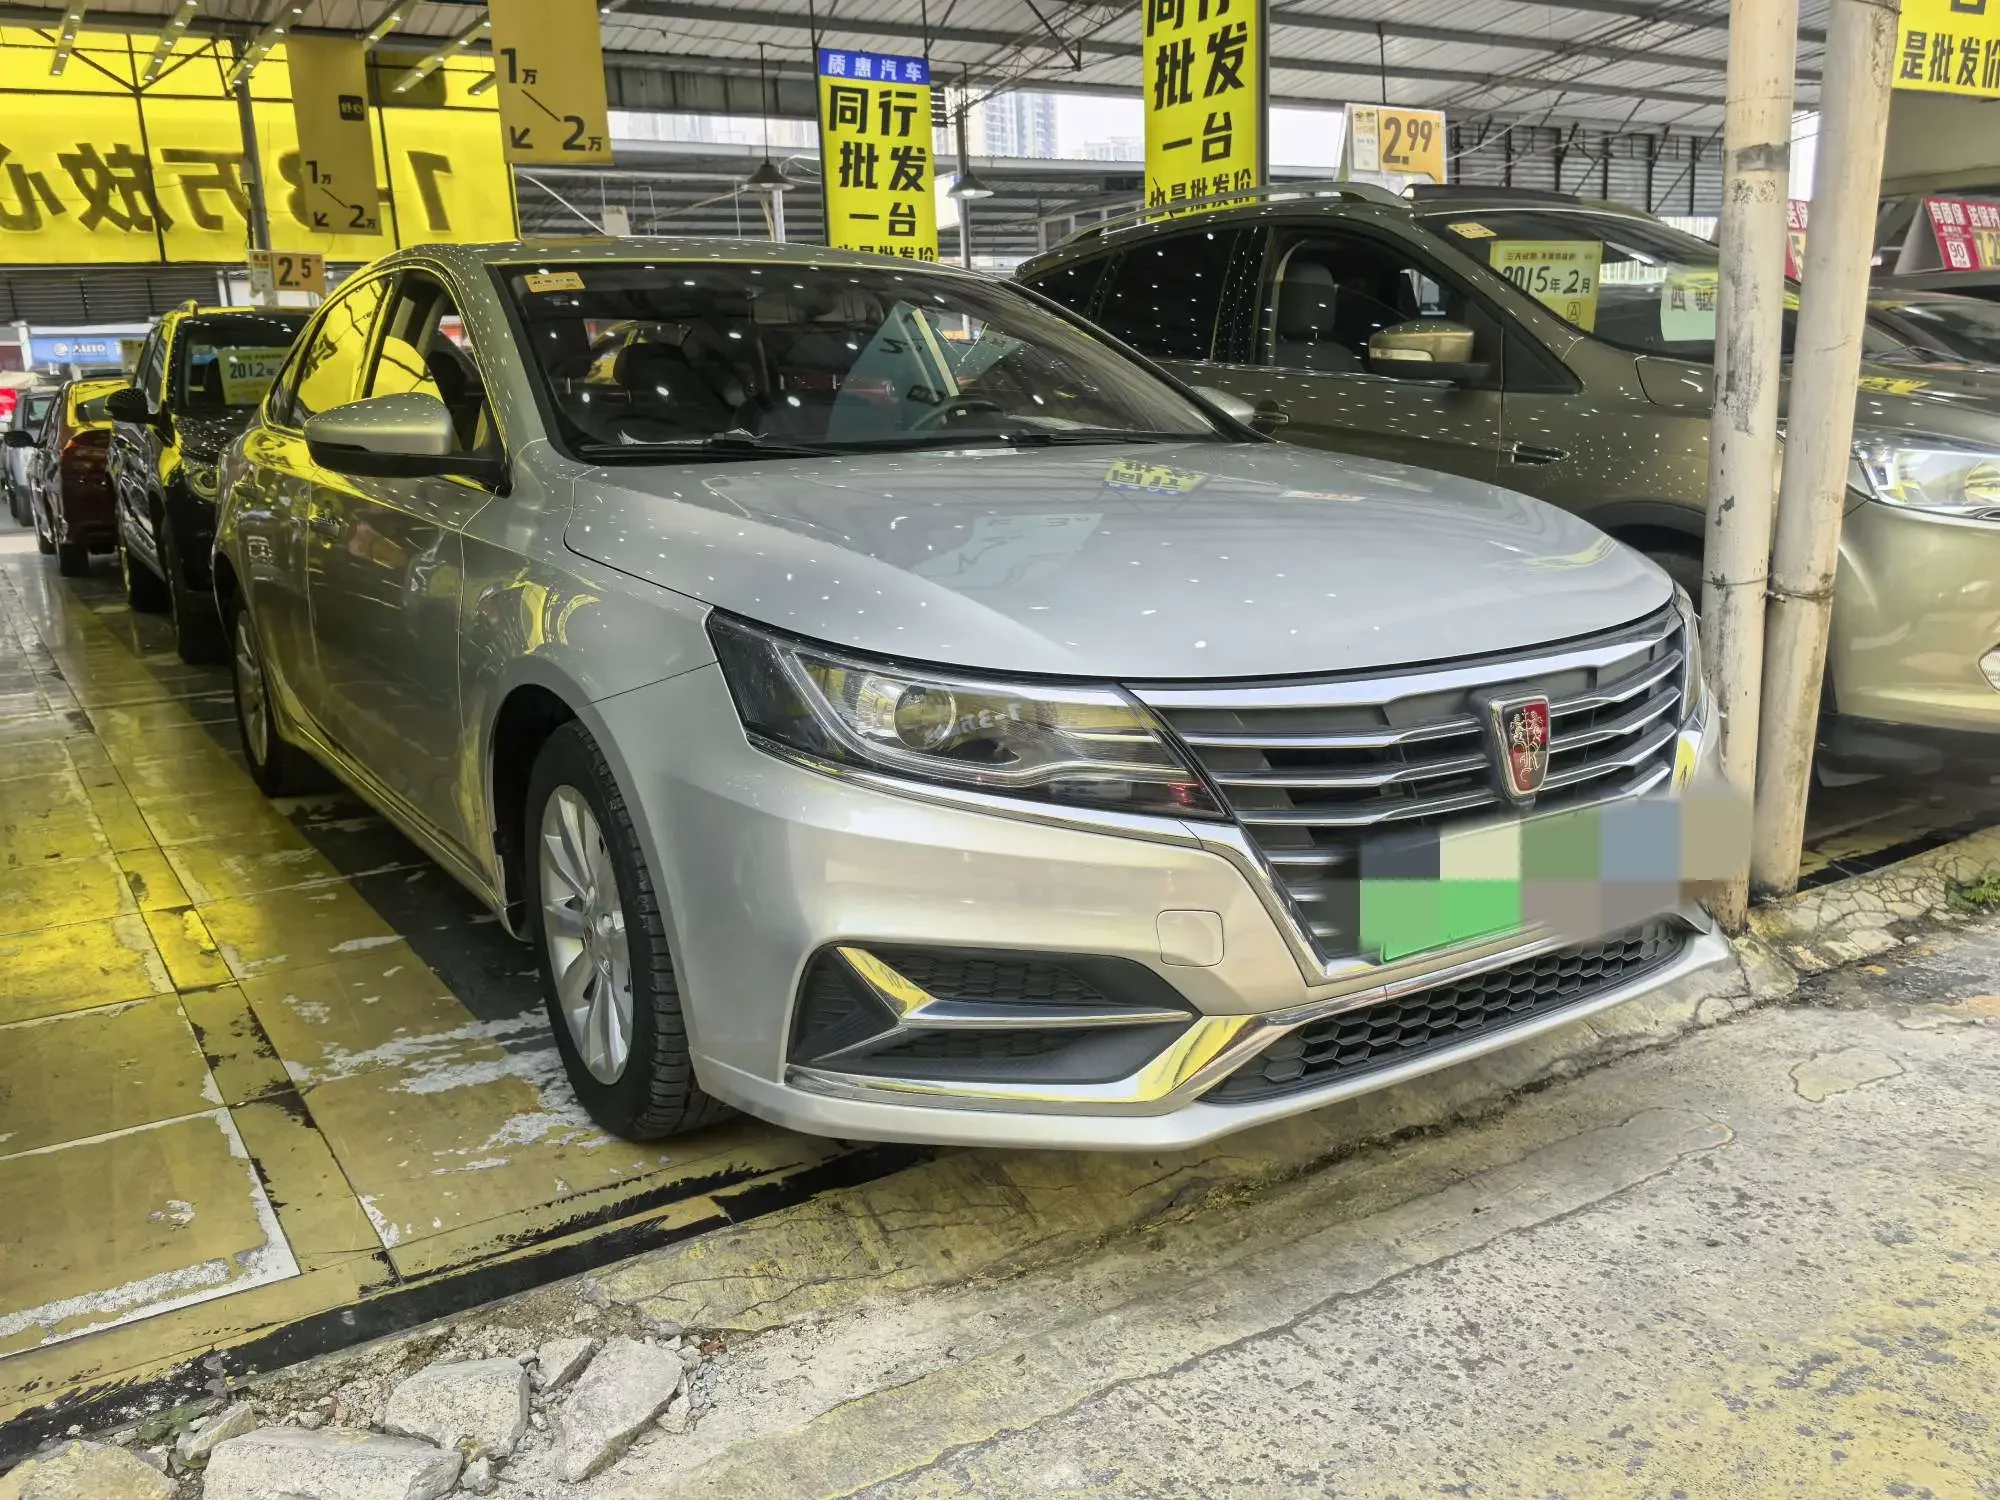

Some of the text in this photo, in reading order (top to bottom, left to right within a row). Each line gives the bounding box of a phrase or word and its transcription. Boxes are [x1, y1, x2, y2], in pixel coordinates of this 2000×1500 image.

[500, 48, 538, 84] 1万
[827, 54, 922, 82] 质惠汽车
[1154, 21, 1248, 112] 批发
[829, 84, 918, 137] 同行
[562, 115, 602, 151] 2万
[1162, 111, 1232, 163] 一台
[1383, 116, 1432, 164] 2.99
[306, 160, 332, 184] 1万
[839, 141, 927, 192] 批发
[348, 205, 376, 229] 2万
[849, 202, 916, 236] 一台
[1949, 243, 1965, 259] 90
[278, 256, 312, 286] 2.5
